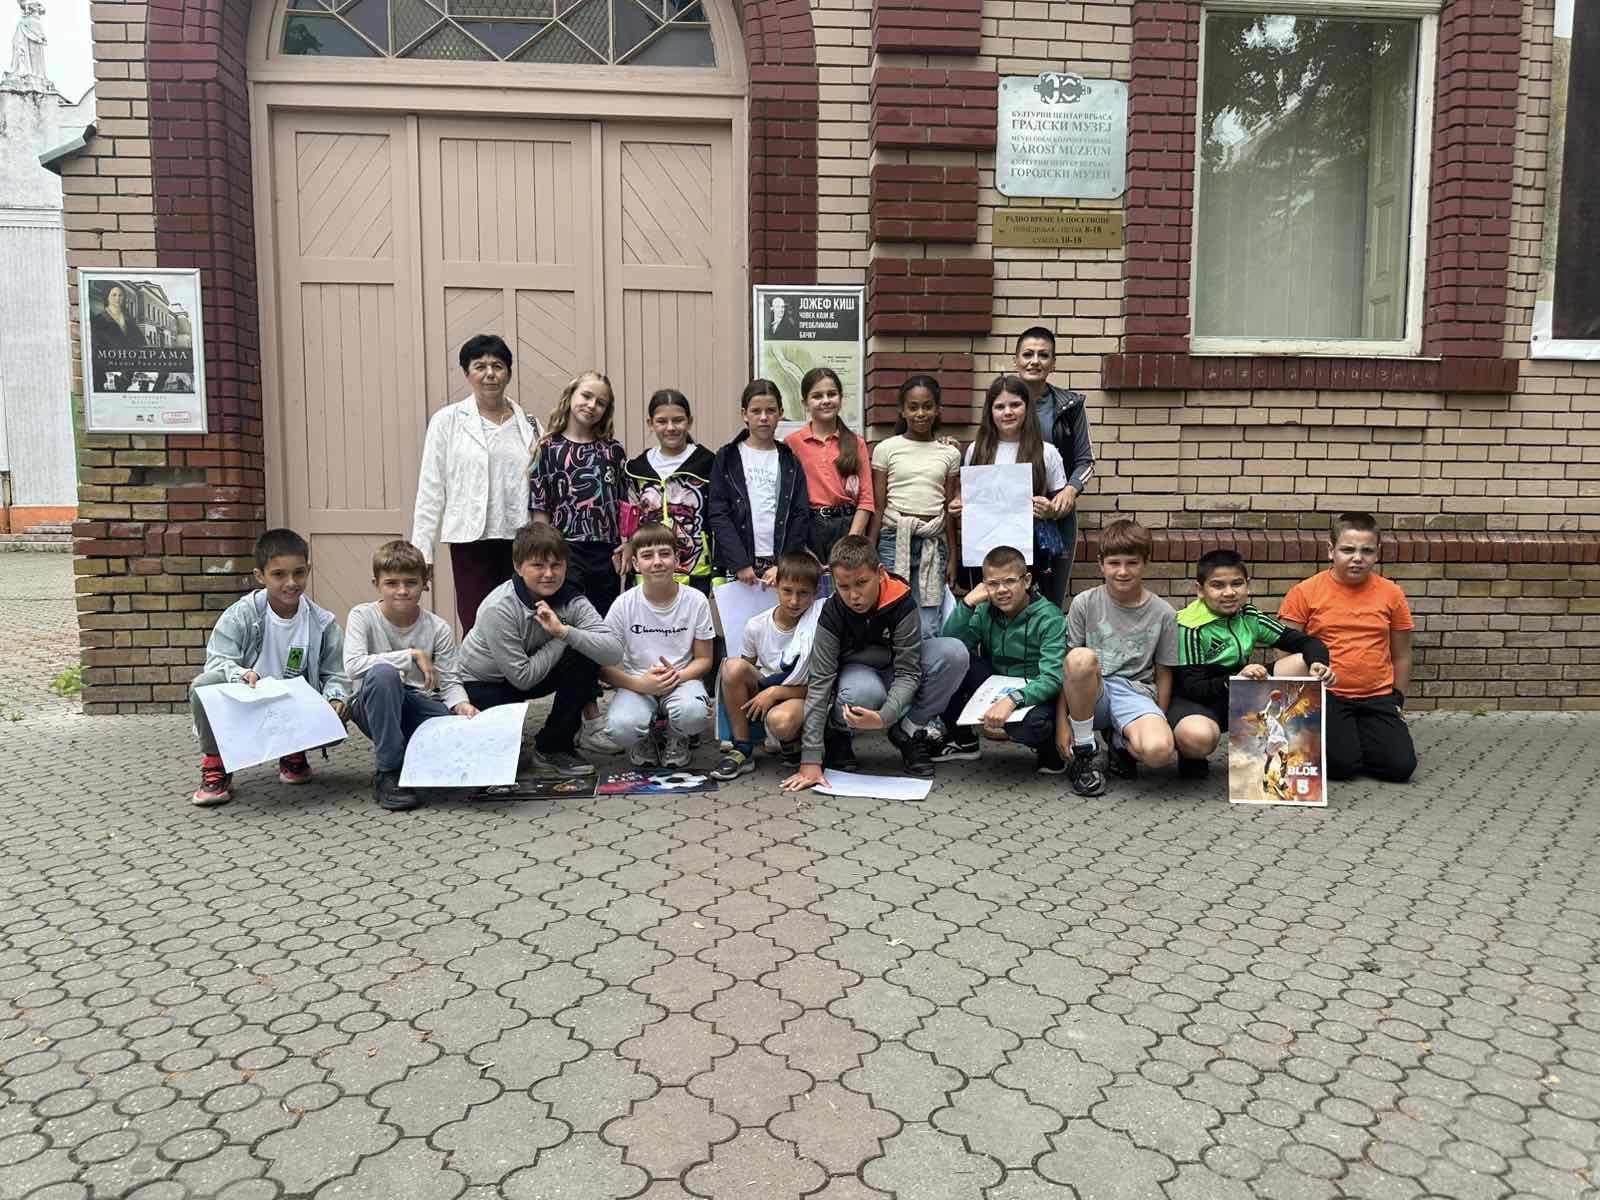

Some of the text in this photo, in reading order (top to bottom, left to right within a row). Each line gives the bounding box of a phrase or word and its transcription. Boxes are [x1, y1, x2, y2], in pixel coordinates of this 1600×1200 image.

[1011, 119, 1112, 132] ГРАДСКИ МУЗЕЈ
[1011, 142, 1056, 154] VÁROSI
[799, 297, 855, 311] ЈОЖЕФ КИШ
[97, 349, 188, 361] МОНОДРАМА
[630, 624, 688, 637] Champion
